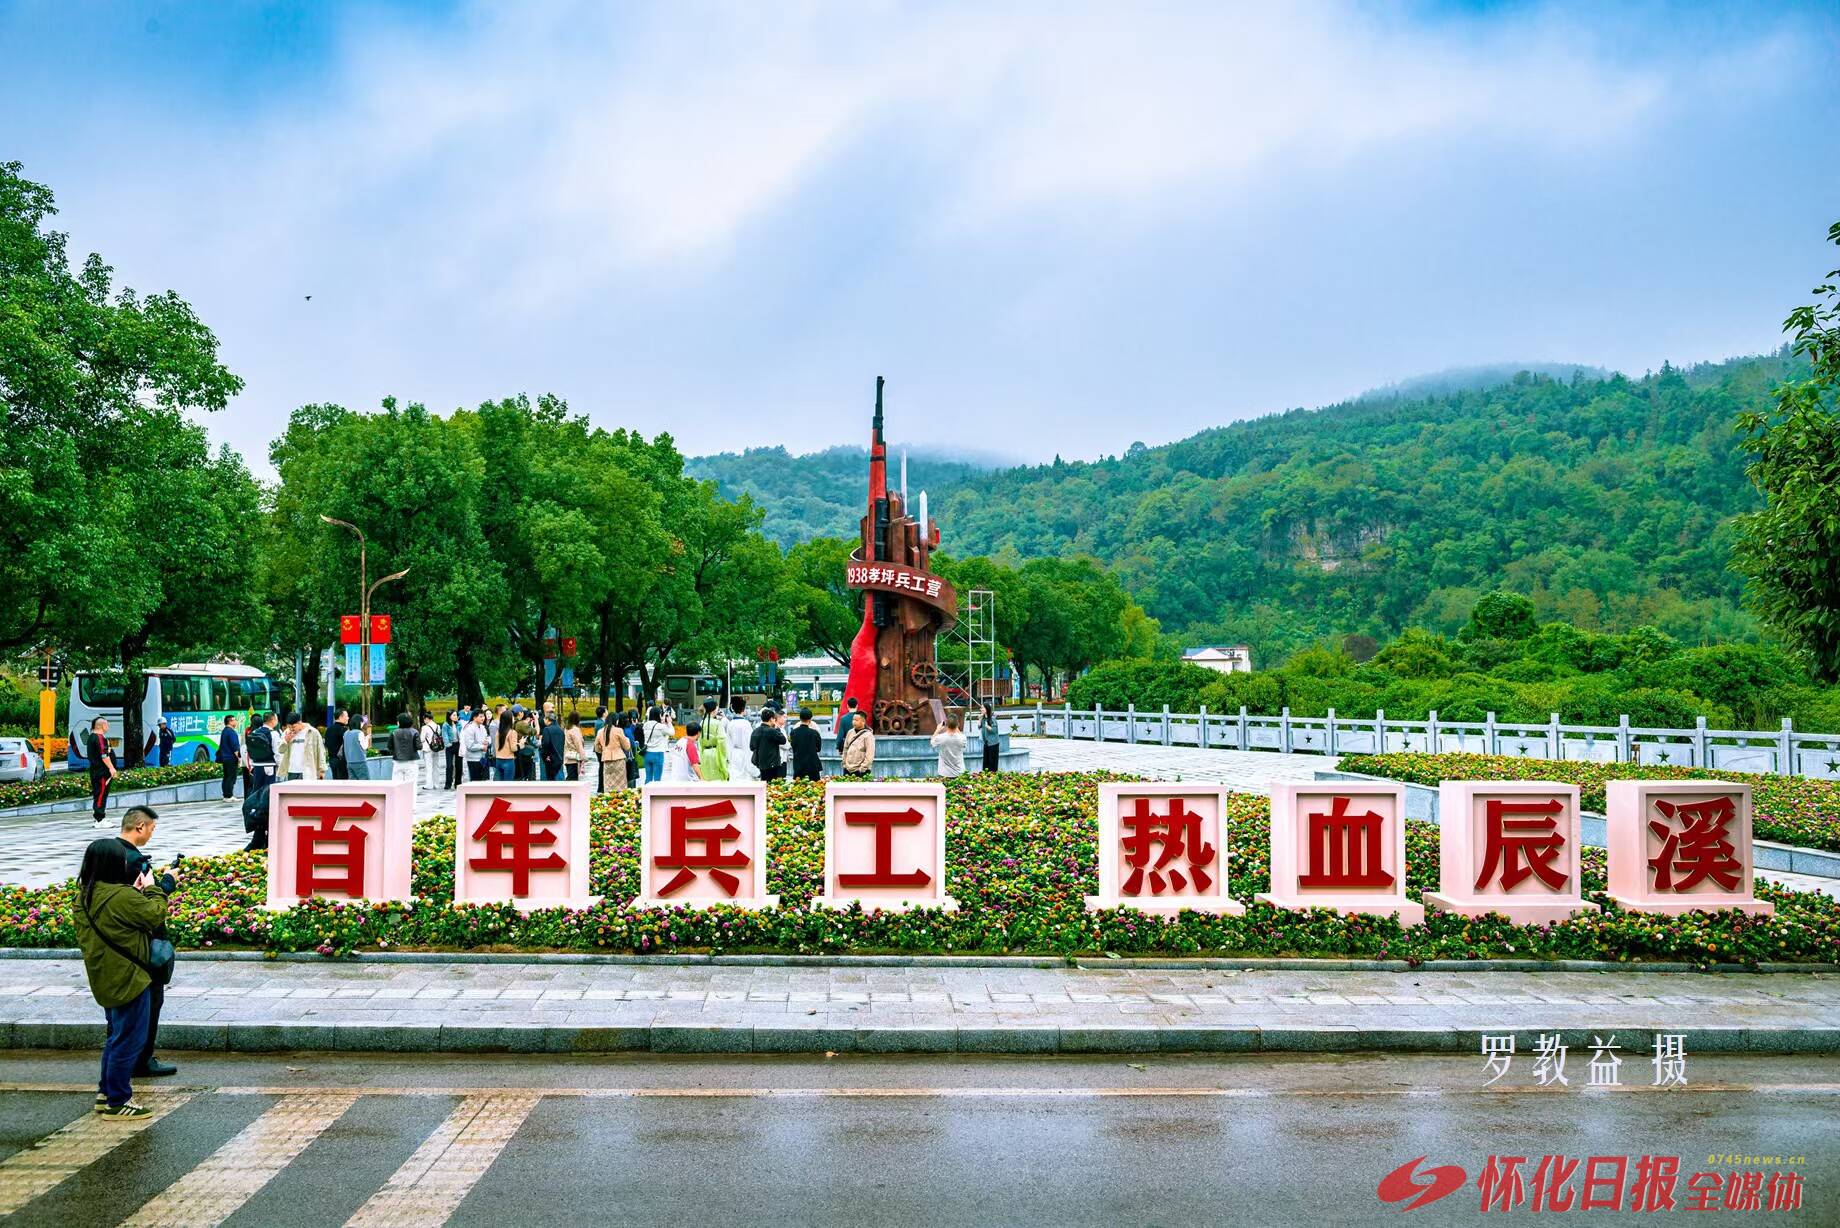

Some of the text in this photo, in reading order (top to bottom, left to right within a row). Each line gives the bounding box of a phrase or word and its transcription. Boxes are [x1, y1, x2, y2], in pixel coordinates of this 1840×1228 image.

[847, 567, 942, 598] 1938孝坪兵工营
[287, 796, 1743, 898] 百年兵工 热血辰溪
